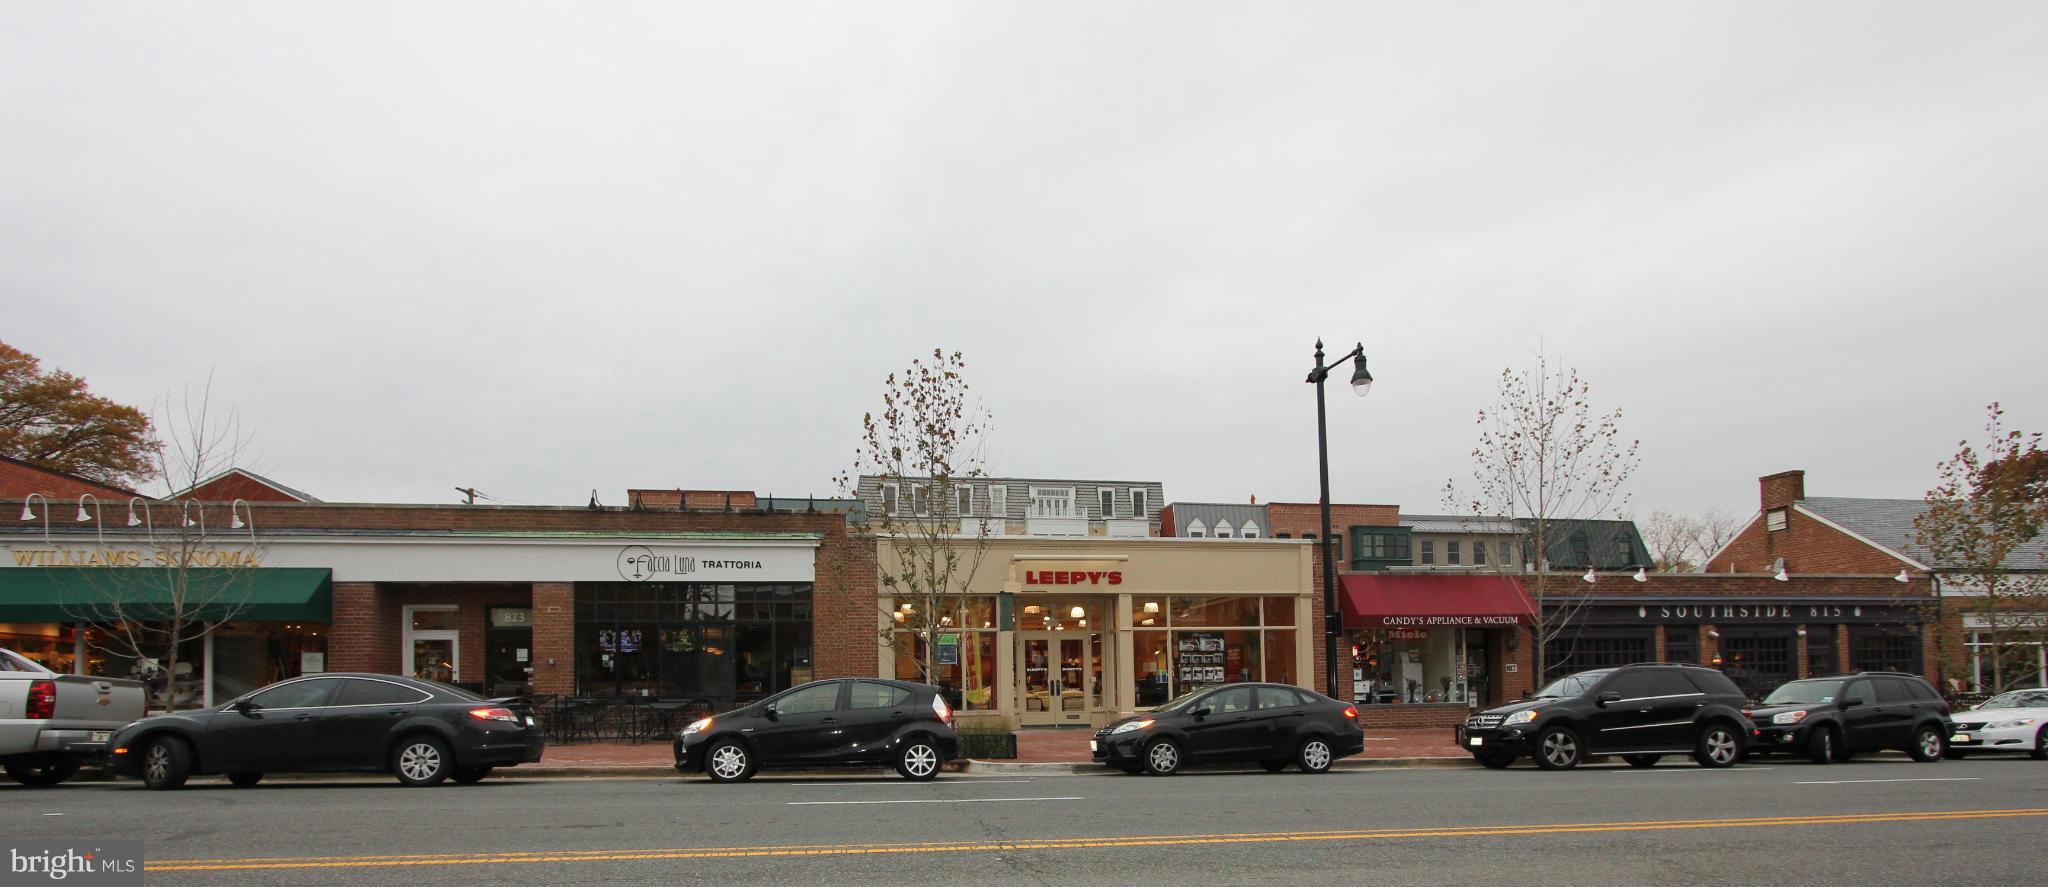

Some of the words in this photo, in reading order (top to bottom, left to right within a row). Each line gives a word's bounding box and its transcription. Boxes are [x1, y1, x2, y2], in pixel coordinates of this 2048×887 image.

[637, 554, 670, 573] Faccia
[674, 554, 696, 575] Luna
[702, 560, 762, 570] TRATTORIA
[504, 612, 526, 623] 823
[1660, 606, 1792, 618] SOUTHSIDE
[1810, 606, 1842, 617] 815
[1383, 616, 1424, 625] CANDY'S
[1426, 616, 1473, 625] APPLIANCE
[1474, 616, 1482, 624] &
[1482, 616, 1519, 624] VACUUM
